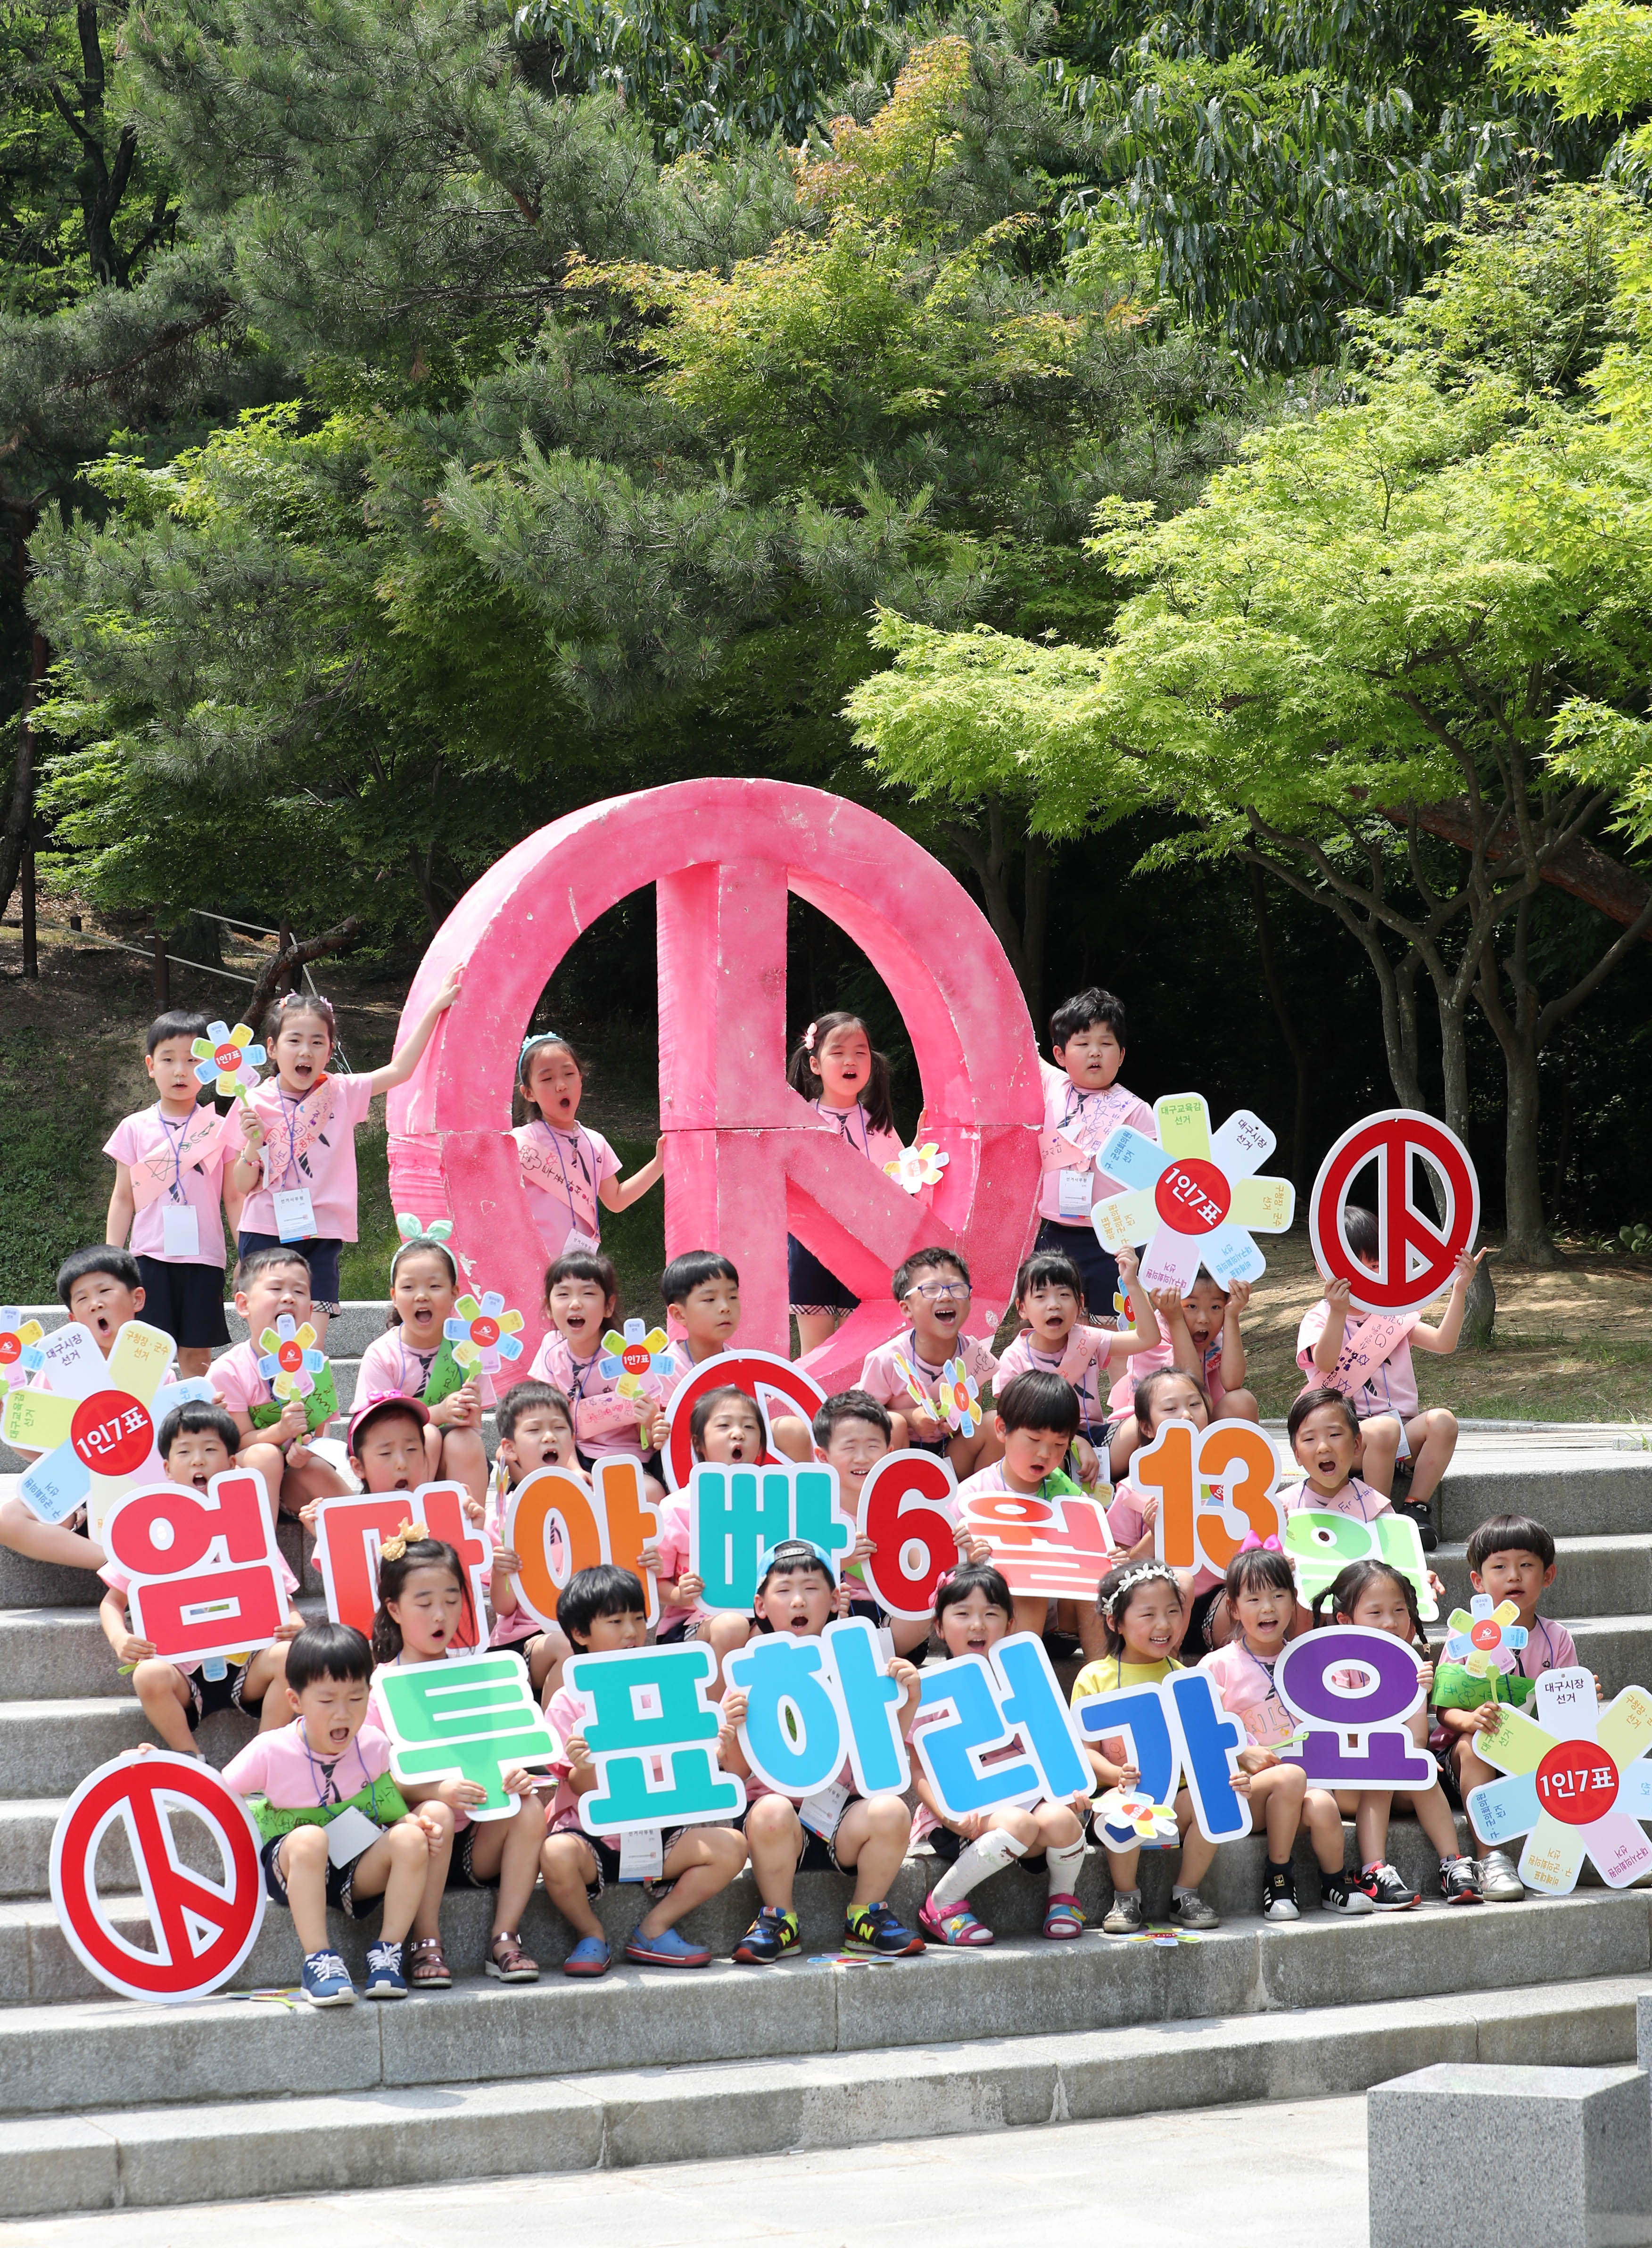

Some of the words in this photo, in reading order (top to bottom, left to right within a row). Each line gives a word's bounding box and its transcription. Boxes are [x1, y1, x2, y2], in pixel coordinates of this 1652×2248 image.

[216, 1050, 241, 1065] 1인7표
[1161, 1102, 1201, 1115] 대구교육감
[1174, 1115, 1191, 1125] 선거
[1237, 1119, 1267, 1149] 대구시장
[1236, 1134, 1253, 1150] 선거
[1122, 1150, 1135, 1164] 선거
[1165, 1167, 1222, 1226] 1인7표
[1262, 1196, 1272, 1210] 선거
[1124, 1213, 1136, 1226] 선거
[1221, 1243, 1234, 1256] 선거
[1164, 1262, 1176, 1273] 선거
[46, 1333, 83, 1359] 대구시장
[61, 1349, 81, 1366] 선거
[133, 1347, 149, 1361] 선거
[623, 1354, 650, 1365] 1인7표
[10, 1392, 25, 1438] 대구교육감
[24, 1408, 35, 1428] 선거
[76, 1405, 149, 1459] 1인7표
[44, 1481, 59, 1497] 선거
[1545, 1678, 1584, 1693] 대구시장
[1556, 1693, 1576, 1705] 선거
[1626, 1713, 1642, 1730] 선거
[1498, 1728, 1514, 1747] 선거
[1540, 1766, 1615, 1798] 1인7표
[1640, 1782, 1651, 1795] 선거
[1494, 1803, 1506, 1818] 선거
[1547, 1848, 1561, 1860] 선거
[1614, 1844, 1628, 1858] 선거
[1608, 1847, 1649, 1879] 대구시의회의원
[1534, 1870, 1560, 1886] 비례대표
[778, 1928, 792, 1947] N
[859, 1922, 875, 1941] N
